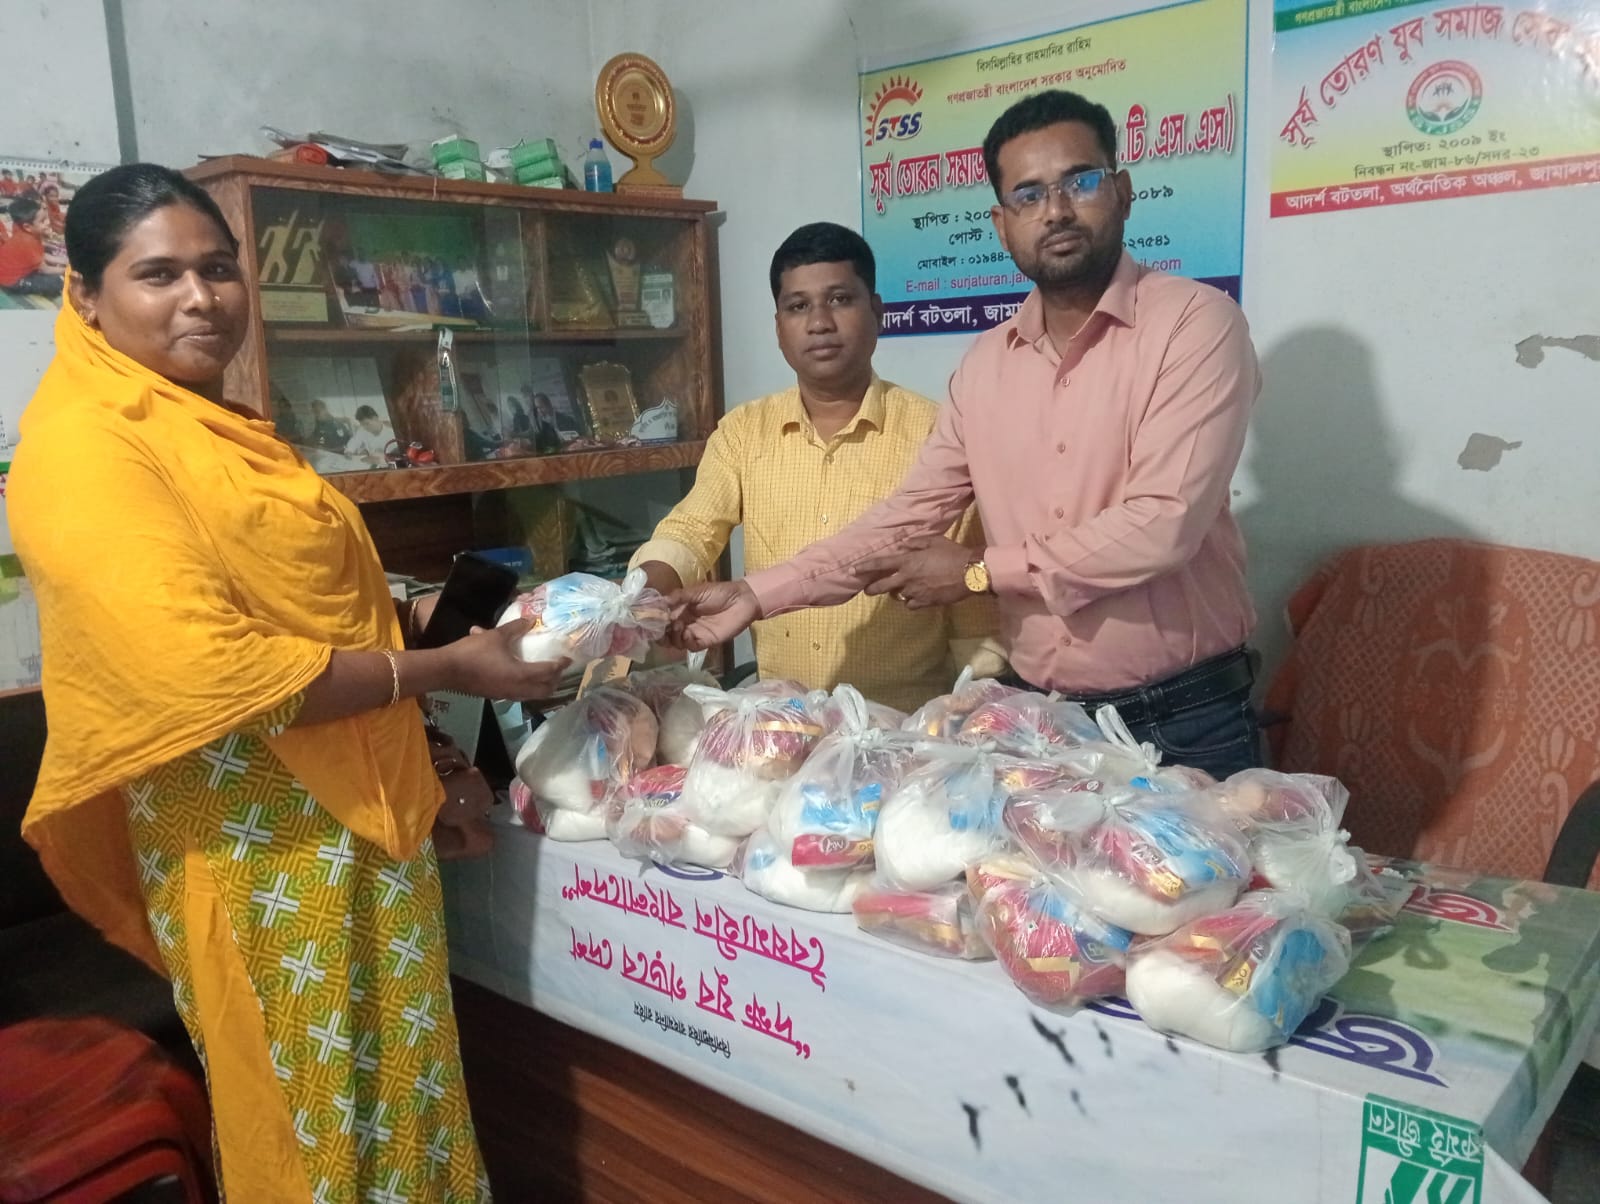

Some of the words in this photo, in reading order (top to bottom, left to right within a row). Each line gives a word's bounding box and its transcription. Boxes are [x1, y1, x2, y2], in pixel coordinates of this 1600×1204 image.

[1066, 36, 1092, 53] রাহিম
[1320, 33, 1384, 107] তোরণ
[1390, 16, 1426, 62] যুব
[1433, 5, 1505, 41] সমাজ
[996, 76, 1037, 96] বাংলাদেশ
[1041, 69, 1073, 86] সরকার
[1076, 57, 1127, 80] অনুমোদিত
[876, 111, 923, 141] STSS
[1439, 134, 1482, 149] ২০০৯
[896, 154, 941, 196] তোরন
[1286, 187, 1325, 209] আদর্শ
[1529, 158, 1600, 184] জামালপু
[949, 228, 984, 245] পোস্ট
[964, 210, 992, 223] ২০০
[917, 255, 957, 270] মোবাইল
[968, 251, 1013, 265] ০১৯৪৪-
[906, 279, 940, 293] E-mail
[569, 926, 613, 970] দেশ
[692, 897, 827, 993] বৈষম্যহীন
[620, 943, 687, 1003] গড়বে
[694, 966, 736, 1021] যুব
[1366, 1104, 1421, 1158] জীবন
